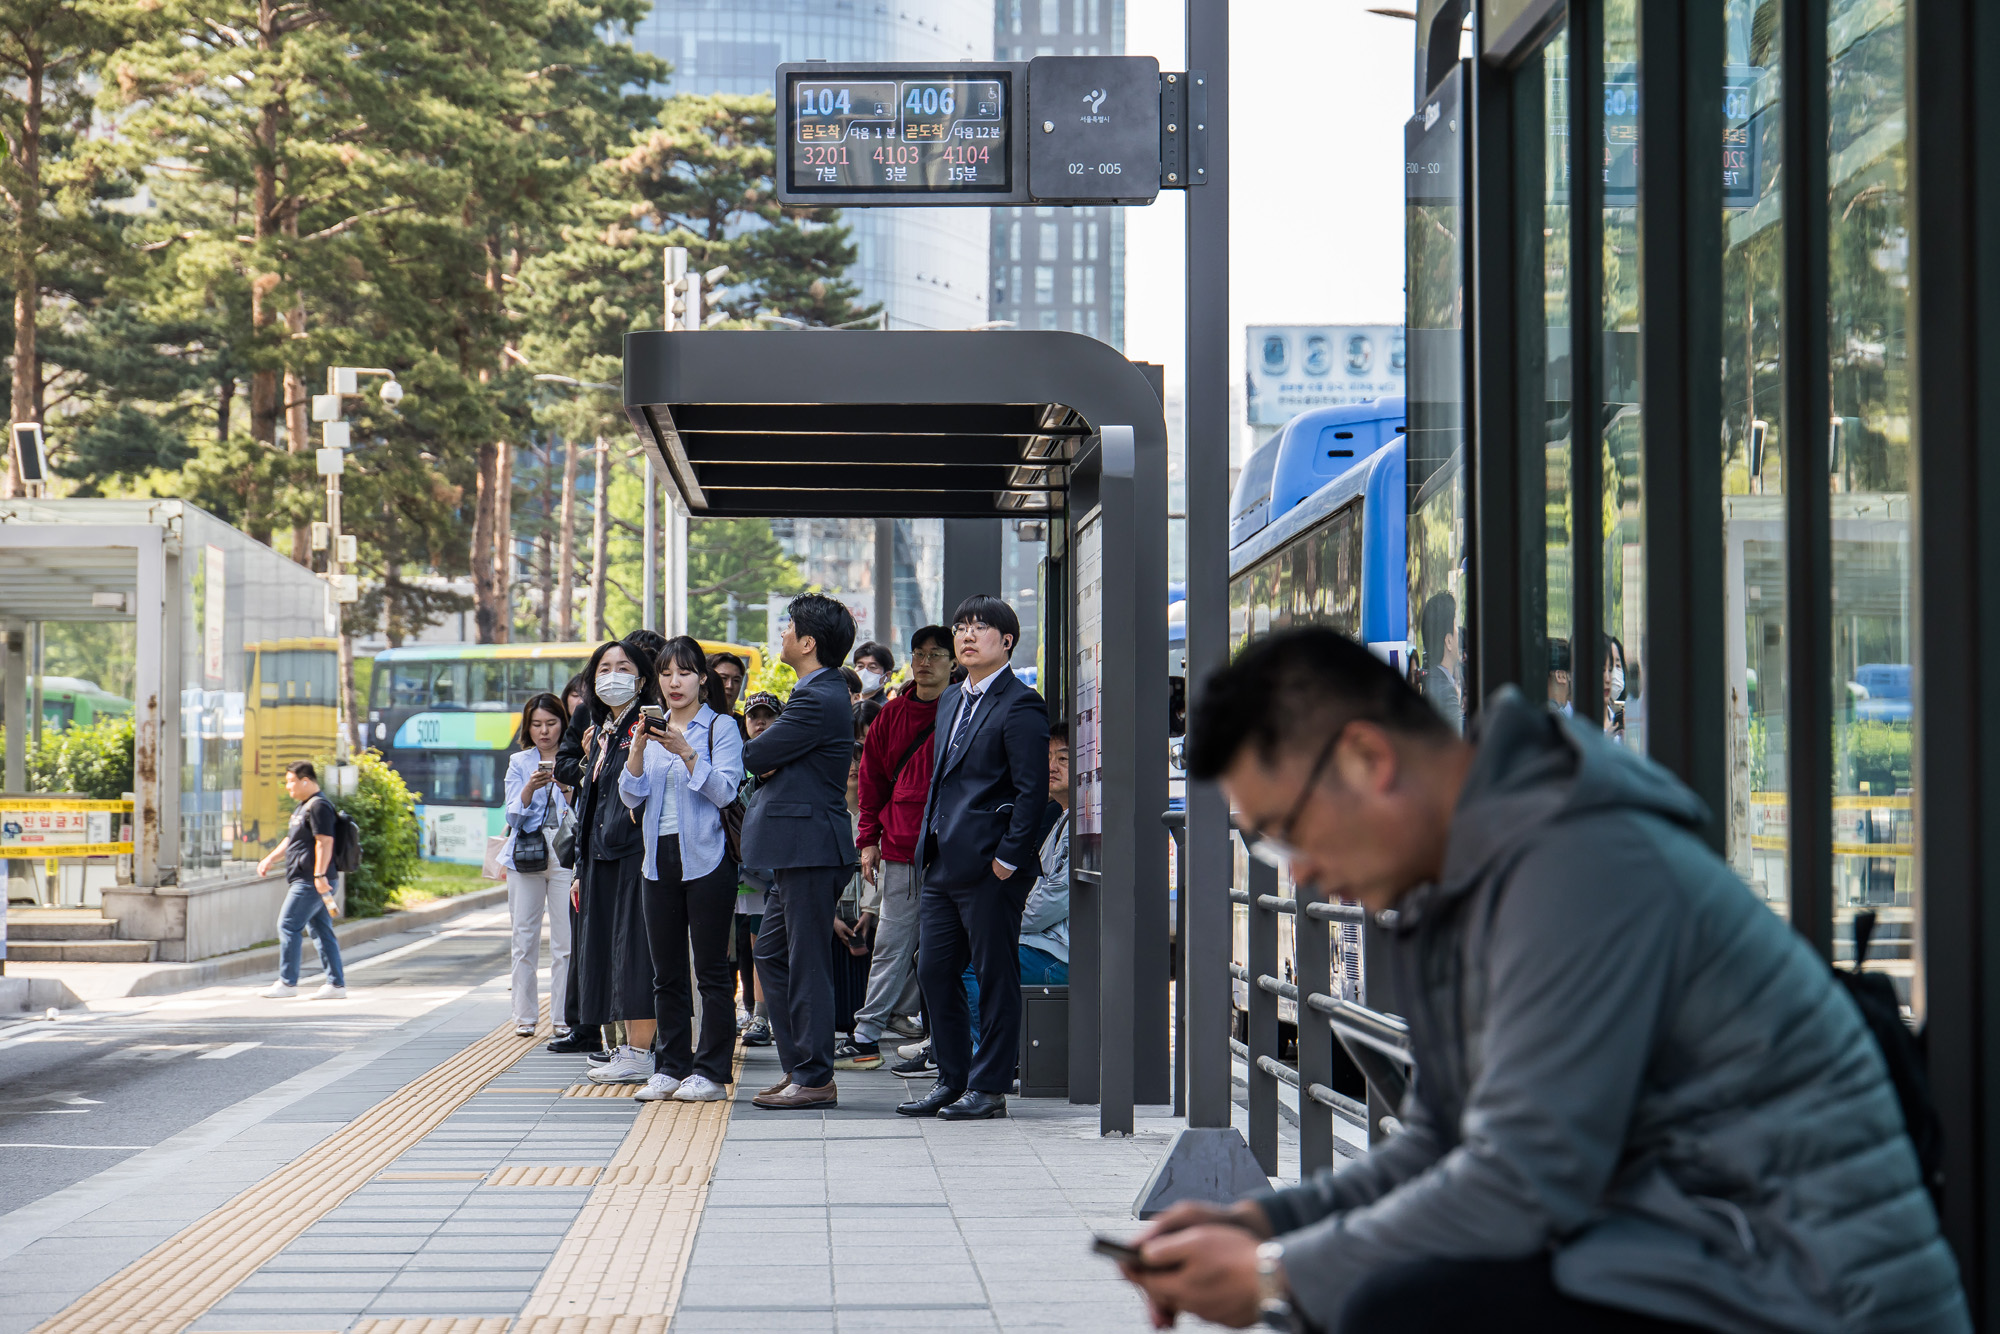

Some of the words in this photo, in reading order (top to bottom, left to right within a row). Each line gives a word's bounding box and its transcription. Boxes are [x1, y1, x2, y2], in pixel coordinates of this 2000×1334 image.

[802, 88, 851, 115] 104
[905, 87, 955, 115] 406
[1080, 115, 1110, 123] 서울특별시
[802, 124, 840, 139] 곧도착
[850, 127, 870, 139] 다음
[906, 123, 944, 139] 곧도착
[954, 127, 974, 139] 다음
[976, 127, 1001, 138] 12분
[803, 146, 849, 165] 3201
[873, 146, 919, 164] 4103
[943, 145, 990, 164] 4104
[815, 166, 837, 182] 7분
[885, 166, 907, 182] 3분
[948, 166, 977, 182] 15분
[1068, 163, 1084, 174] 02
[1098, 163, 1121, 174] 005
